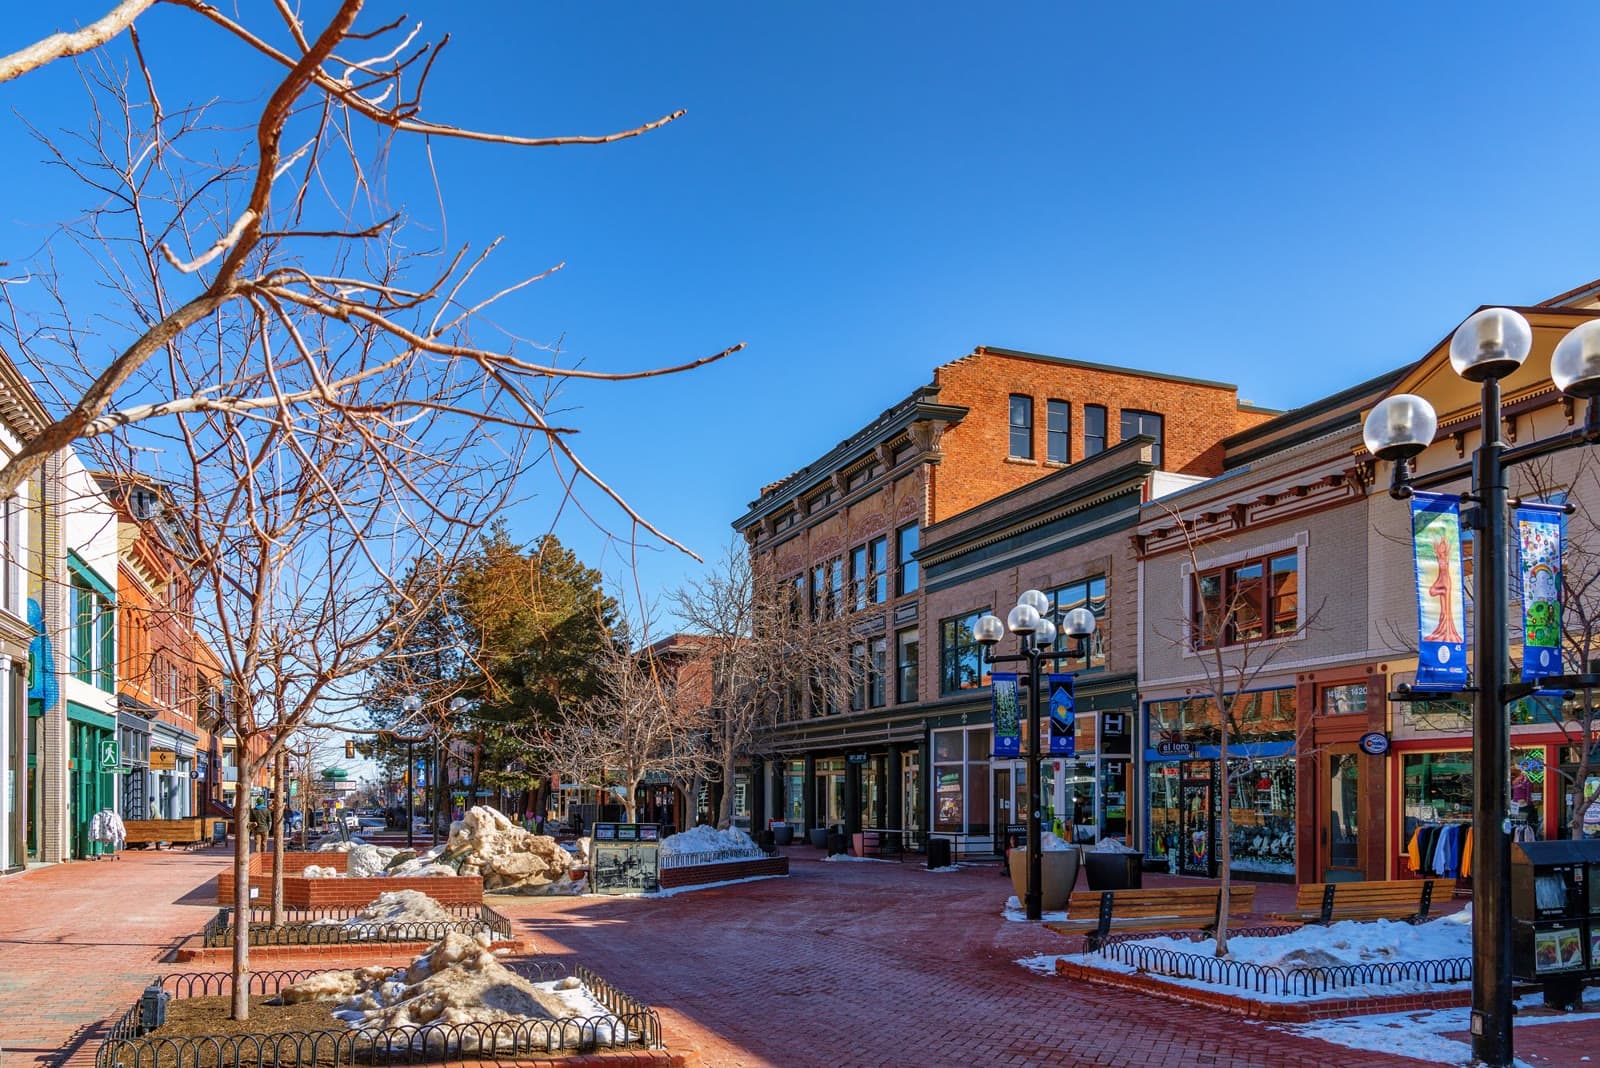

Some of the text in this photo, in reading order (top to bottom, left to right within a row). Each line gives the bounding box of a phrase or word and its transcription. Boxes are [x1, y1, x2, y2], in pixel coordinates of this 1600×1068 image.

[1351, 687, 1368, 696] 1420
[1163, 743, 1171, 751] el
[1519, 758, 1544, 772] OPE
